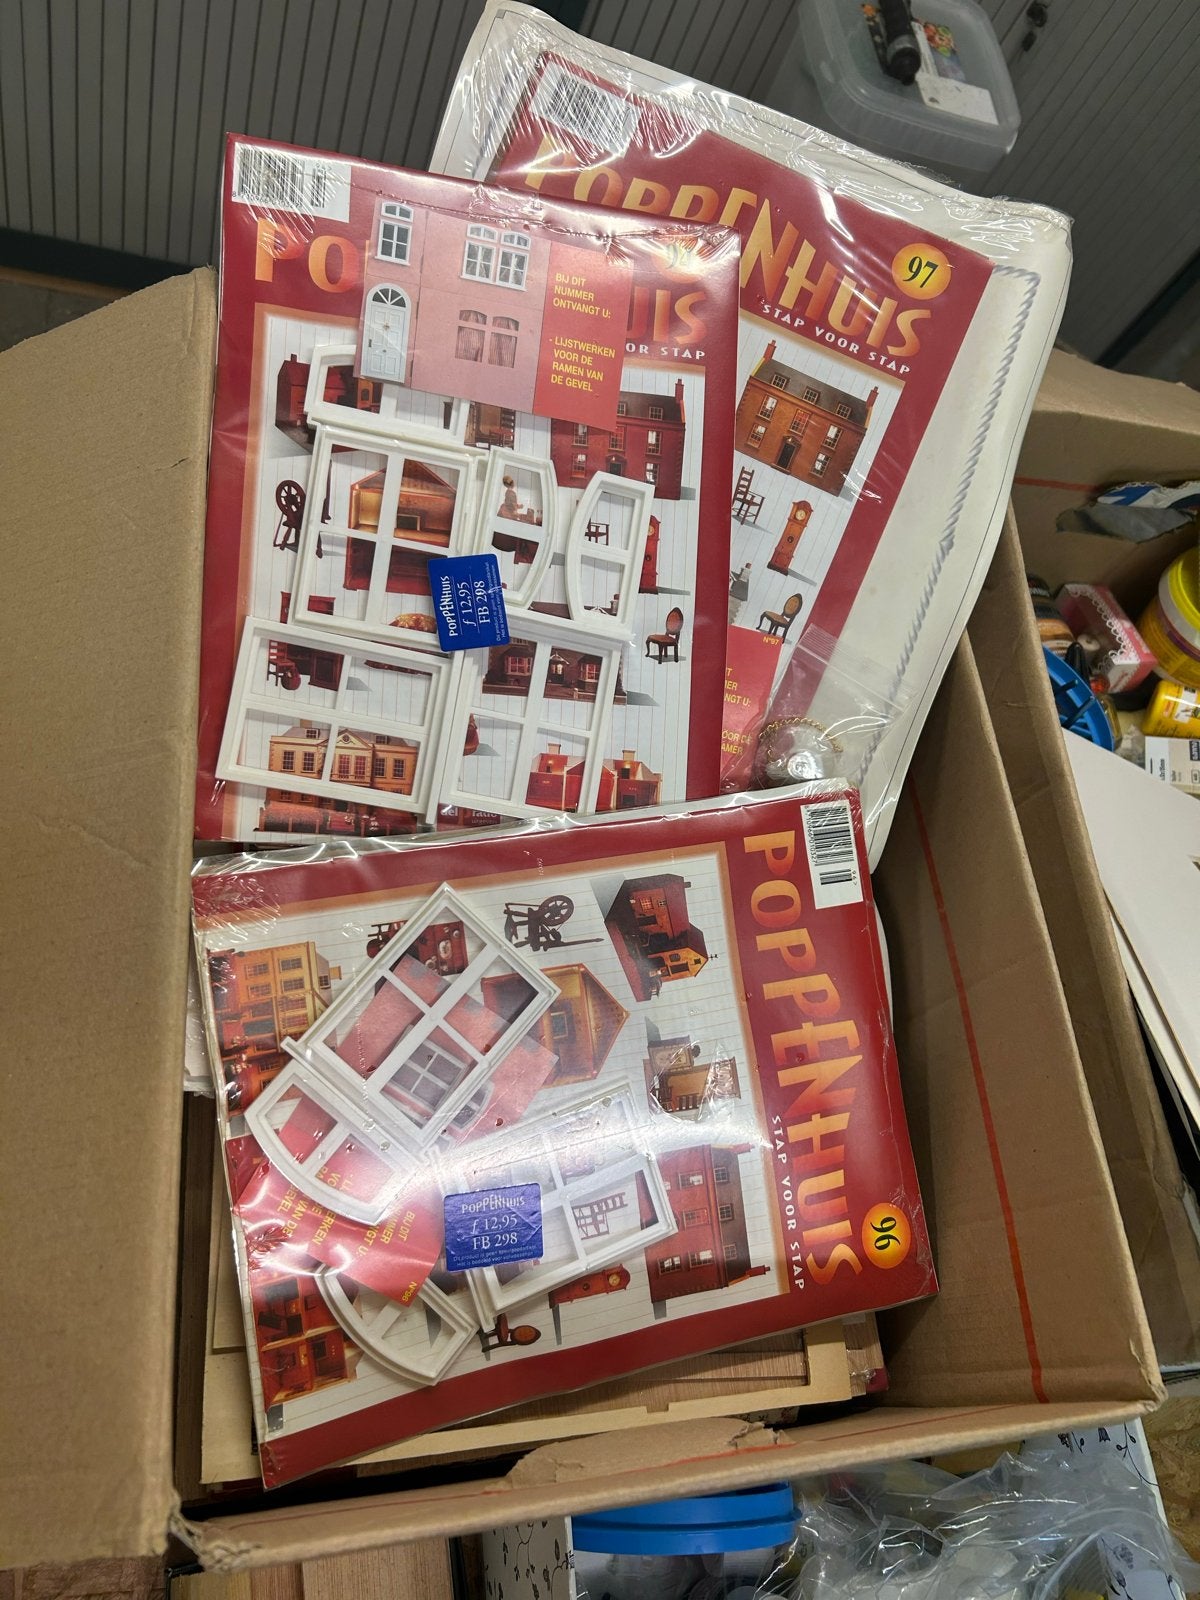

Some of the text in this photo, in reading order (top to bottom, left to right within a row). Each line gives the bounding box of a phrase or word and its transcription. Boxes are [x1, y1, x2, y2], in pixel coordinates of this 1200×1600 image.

[556, 273, 586, 287] BIJ DIT
[902, 255, 938, 289] 97
[554, 285, 594, 301] NUMMER
[553, 298, 611, 318] ONTVANGT U:
[555, 336, 616, 358] LIJSTWERKEN
[763, 304, 910, 375] STAP VOOR STAP
[554, 349, 593, 366] VOOR DE
[626, 342, 705, 360] OR STAP
[552, 362, 603, 381] RAMEN VAN
[551, 374, 593, 392] DE GEVEL
[440, 575, 458, 637] POPPENHUIS
[457, 582, 473, 613] 12,95
[473, 581, 490, 623] FB 298
[722, 730, 739, 742] OOR
[721, 743, 743, 754] AMER
[743, 829, 863, 1286] POPPENHUIS
[293, 1199, 309, 1221] VAN
[462, 1194, 526, 1214] POPPENHUIS
[771, 1115, 804, 1290] STAP VOOR STAP
[484, 1214, 518, 1230] 12,95
[473, 1232, 518, 1250] FB 298
[870, 1216, 901, 1251] 96
